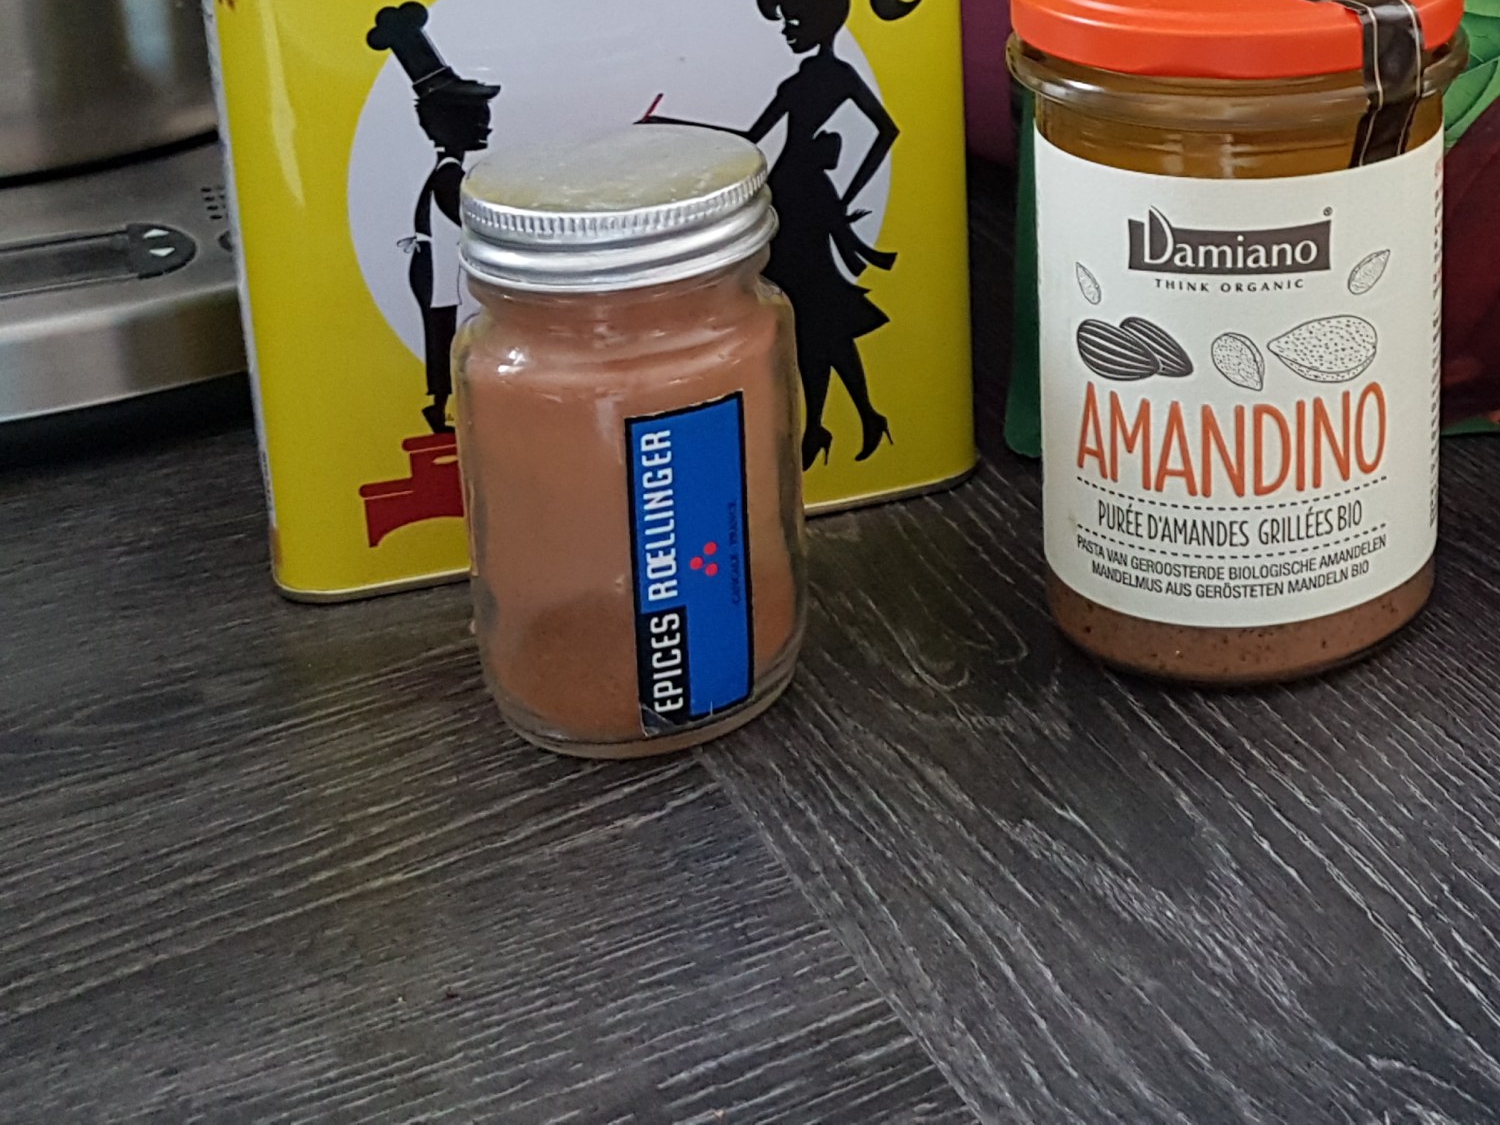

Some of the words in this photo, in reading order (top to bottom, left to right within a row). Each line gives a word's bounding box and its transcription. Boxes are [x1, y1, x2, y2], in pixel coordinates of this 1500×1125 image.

[1144, 205, 1318, 268] Damiano
[1155, 278, 1210, 293] THINK
[1220, 278, 1304, 293] ORGANIC
[1077, 381, 1387, 498] AMANDINO
[1097, 498, 1145, 540] PURÉE
[1147, 514, 1250, 548] D'AMANDES
[1258, 504, 1334, 546] GRILLÉES
[1337, 499, 1363, 529] BIO
[1076, 533, 1105, 559] PASTA
[1105, 546, 1129, 568] VAN
[1130, 557, 1226, 581] GEROOSTERDE
[1228, 557, 1318, 581] BIOLOGISCHE
[1318, 534, 1387, 569] AMANDELEN
[1091, 559, 1163, 594] MANDELMUS
[1165, 580, 1192, 598] AUS
[1195, 580, 1285, 599] GERÖSTETEN
[1286, 569, 1350, 594] MANDELN
[1350, 560, 1370, 579] BIO
[651, 611, 684, 715] EPICES
